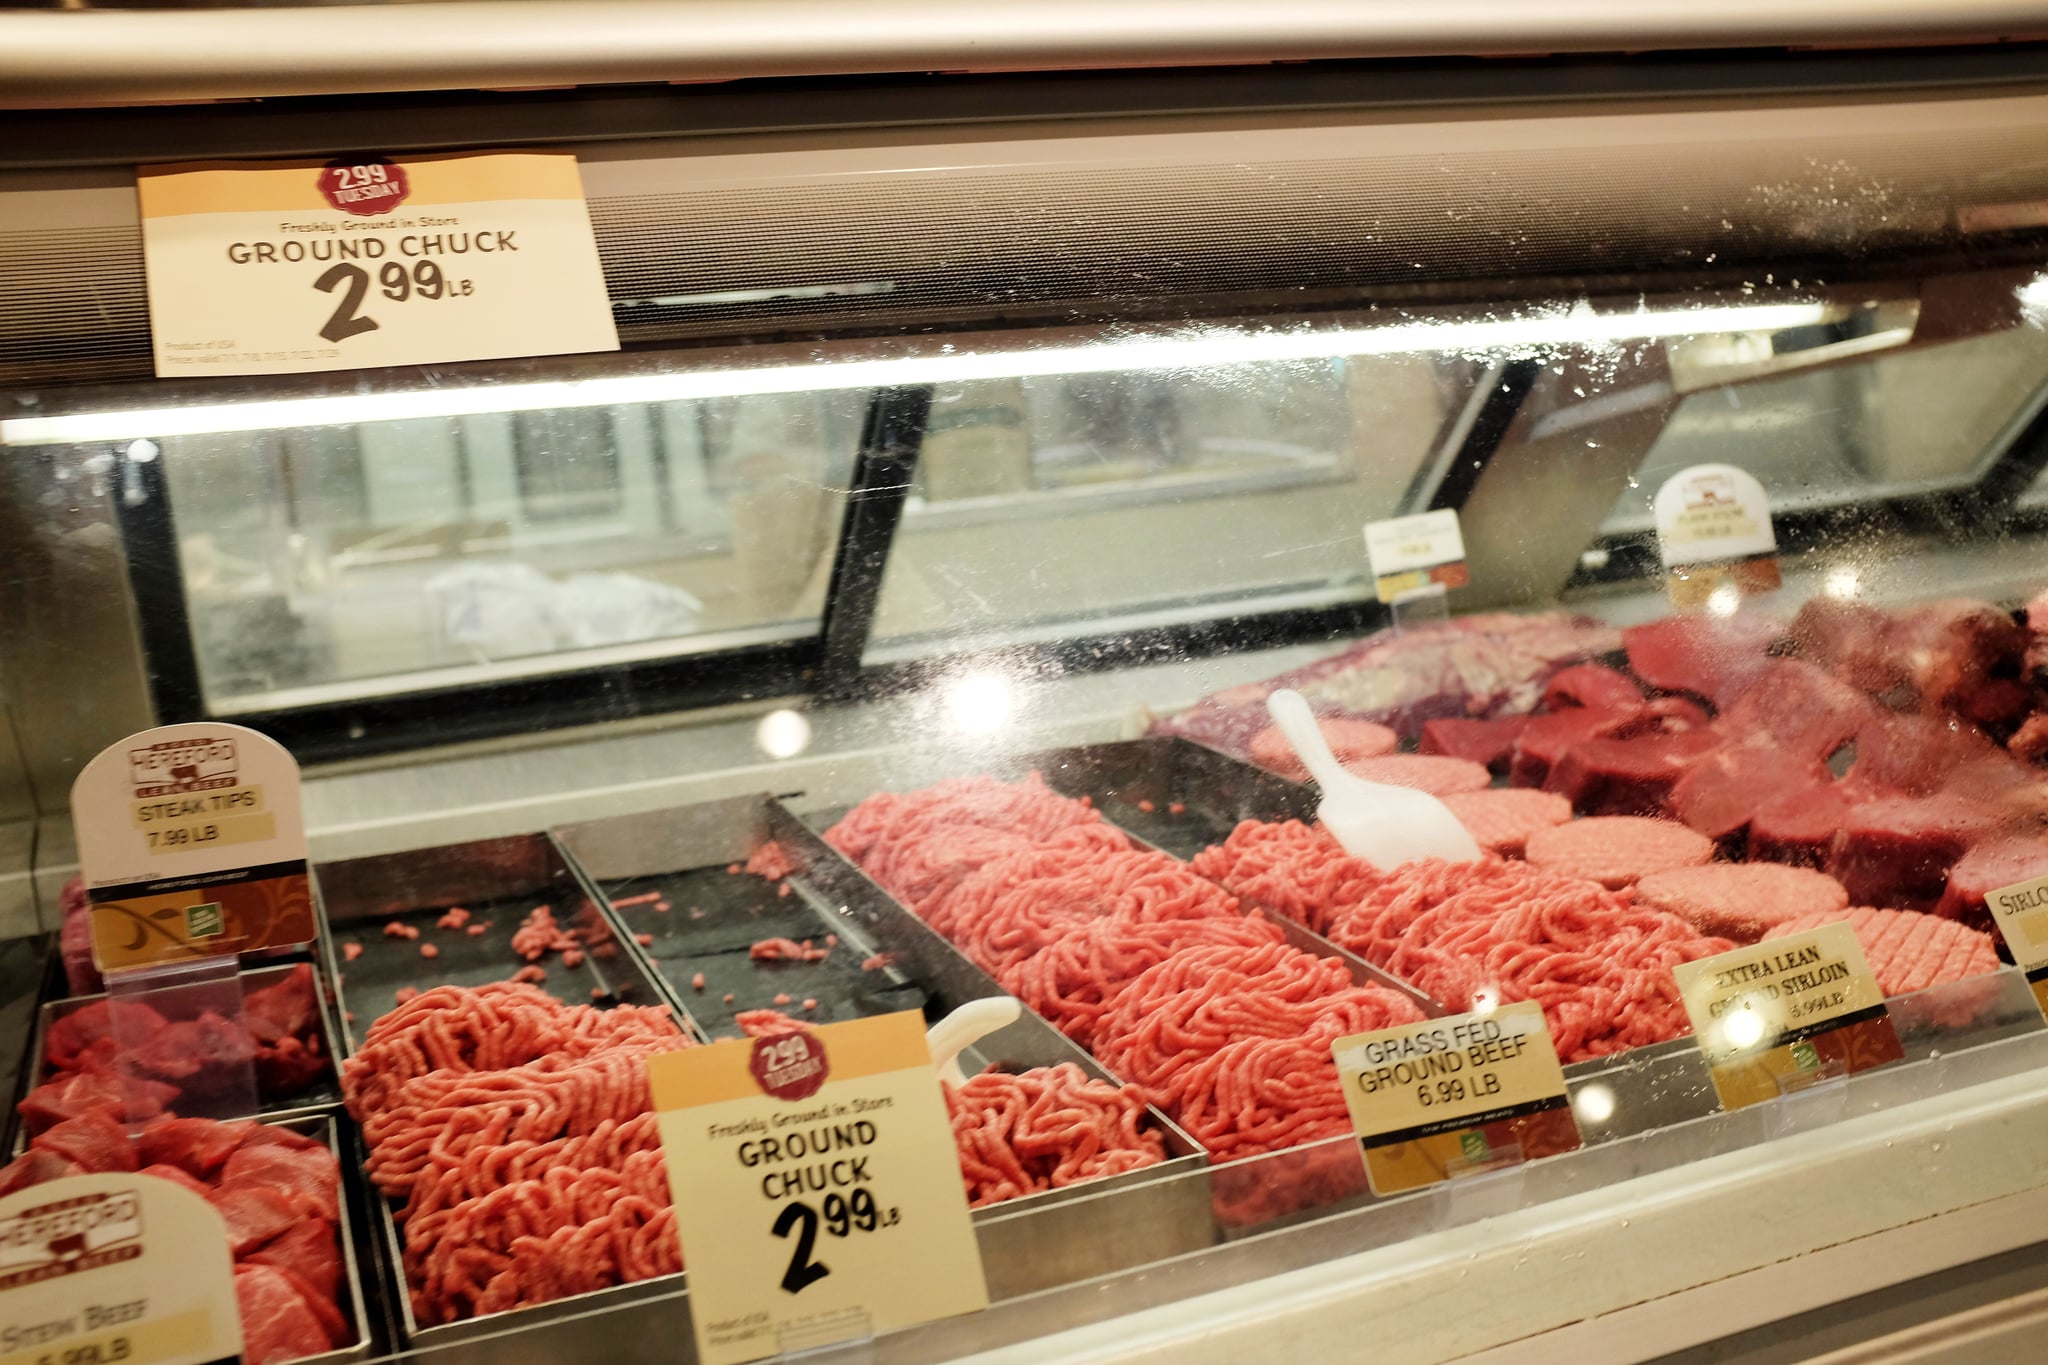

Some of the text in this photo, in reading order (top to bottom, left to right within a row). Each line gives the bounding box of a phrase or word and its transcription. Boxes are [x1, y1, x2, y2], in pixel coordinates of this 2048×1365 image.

[342, 218, 397, 231] Ground
[401, 217, 416, 228] in
[419, 216, 460, 228] Store
[227, 229, 518, 265] GROUND CHUCK
[446, 278, 475, 298] LB
[131, 745, 235, 770] HEREFORD
[137, 790, 256, 823] STEAK TIPS
[147, 825, 219, 848] 7.99 LB
[1715, 945, 1821, 988] EXTRA LEAN
[1781, 960, 1850, 996] SIRLOIN
[1364, 1019, 1502, 1065] GRASS FED
[1358, 1033, 1528, 1094] GROUND BEEF
[1416, 1073, 1501, 1107] 6.99 LB
[772, 1105, 829, 1128] Ground
[738, 1120, 877, 1168] GROUND
[761, 1156, 872, 1200] CHUCK
